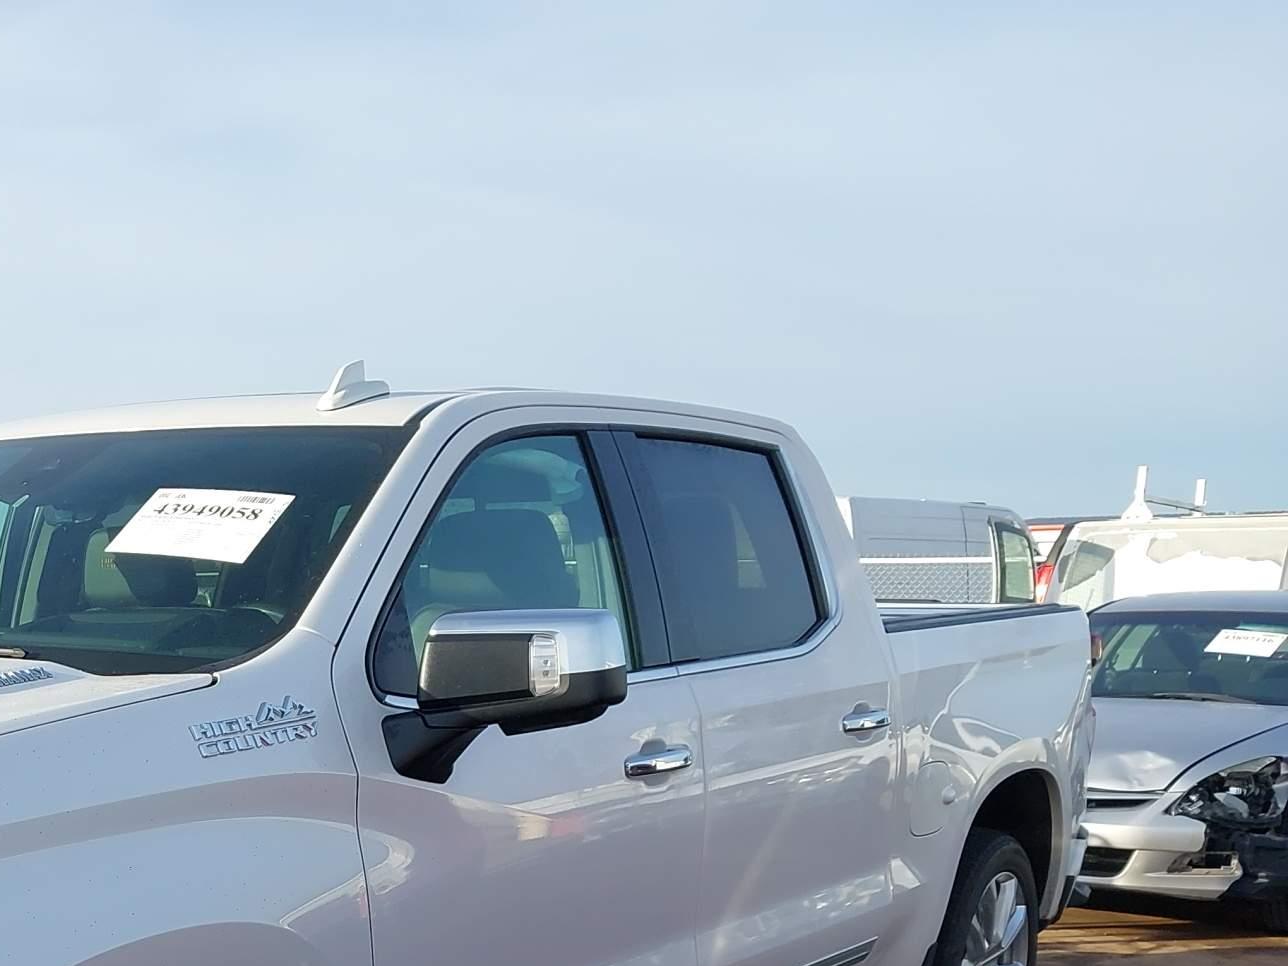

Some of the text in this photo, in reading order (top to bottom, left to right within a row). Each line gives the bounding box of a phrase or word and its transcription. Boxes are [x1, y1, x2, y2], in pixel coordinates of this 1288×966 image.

[152, 503, 265, 522] 43949058
[188, 716, 259, 740] HIGH
[198, 721, 319, 759] COUNTRY
